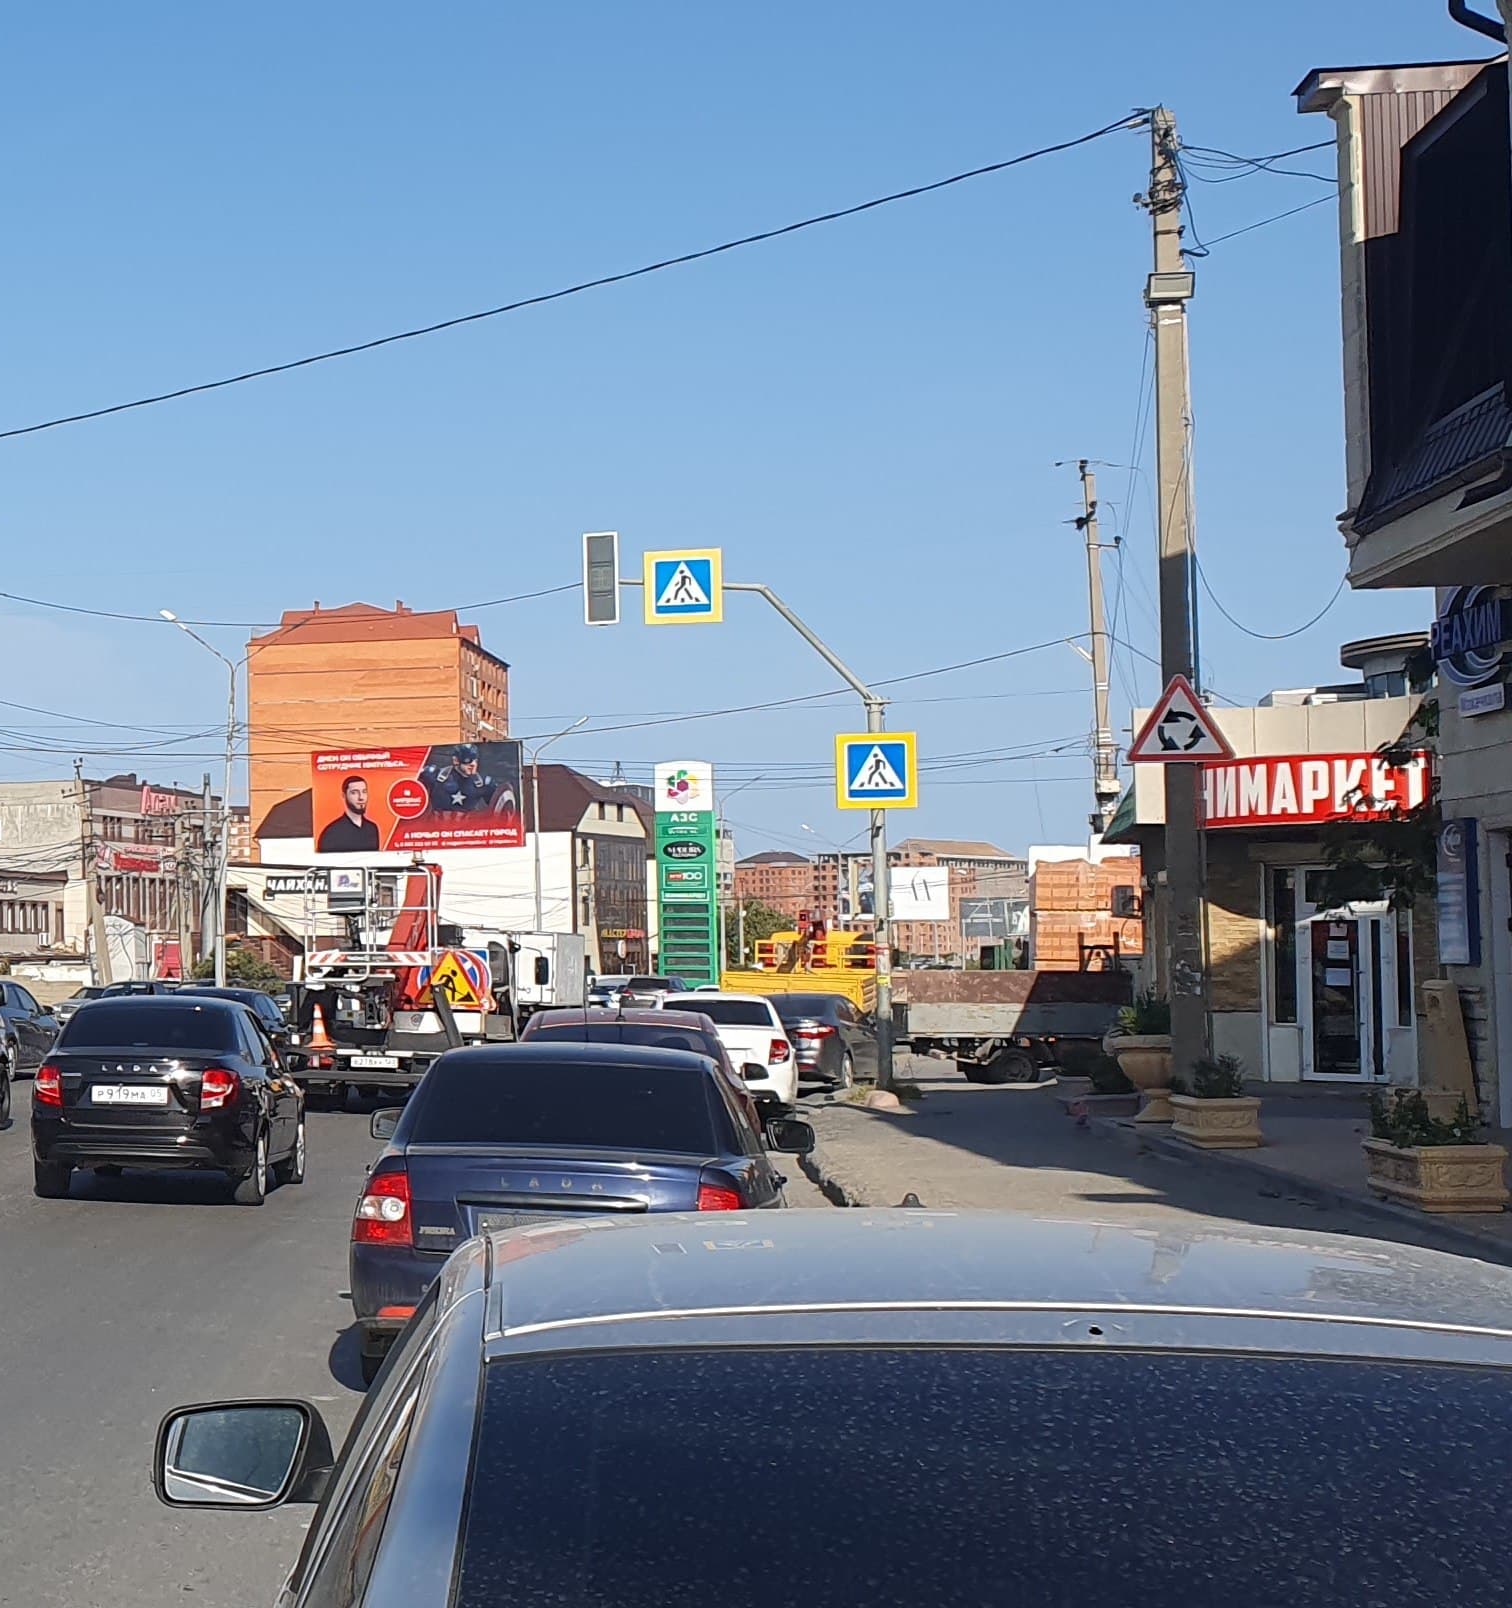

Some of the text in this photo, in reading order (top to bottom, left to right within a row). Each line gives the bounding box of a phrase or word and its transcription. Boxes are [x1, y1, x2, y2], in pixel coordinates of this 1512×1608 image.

[670, 812, 698, 822] АЗС
[268, 878, 328, 891] ЧАЙХАН
[101, 1064, 158, 1073] LADA
[500, 1176, 603, 1192] LADA
